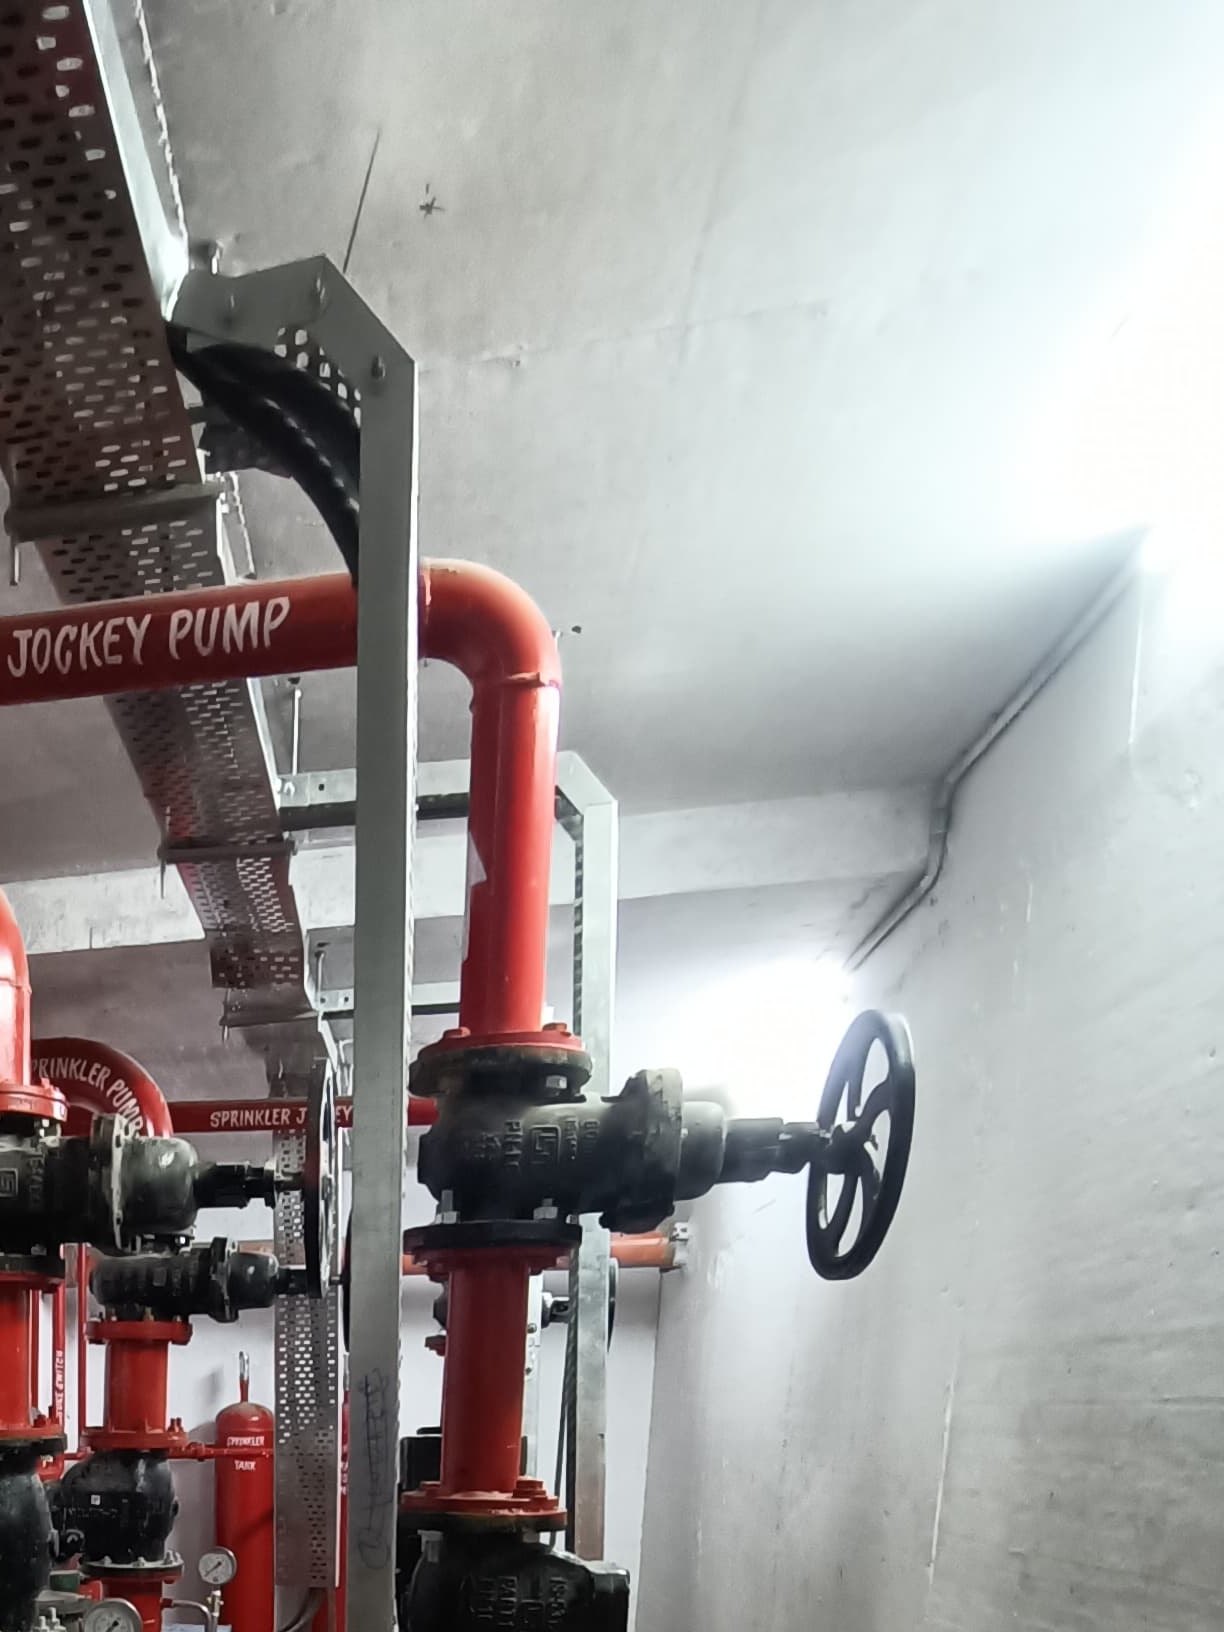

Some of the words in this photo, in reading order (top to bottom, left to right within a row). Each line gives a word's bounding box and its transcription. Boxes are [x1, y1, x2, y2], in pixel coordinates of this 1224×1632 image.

[7, 615, 151, 679] JOCKEY
[167, 596, 291, 658] PUMP
[210, 1107, 291, 1128] SPRINKLER
